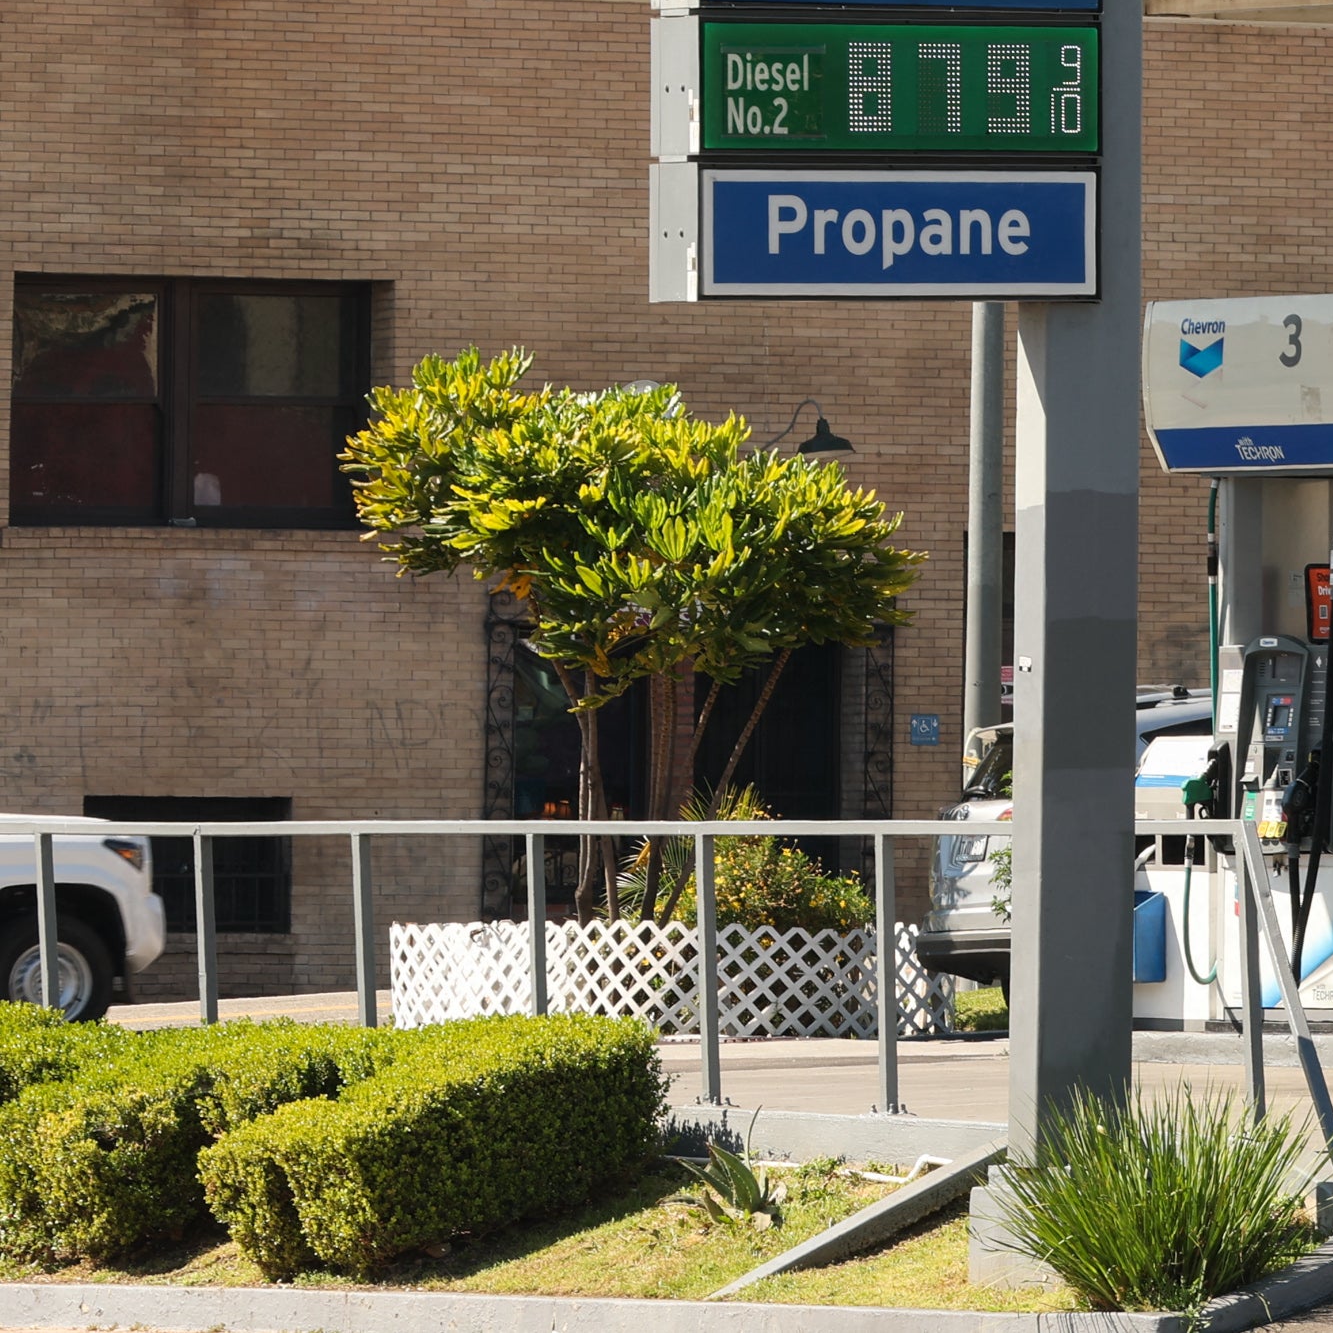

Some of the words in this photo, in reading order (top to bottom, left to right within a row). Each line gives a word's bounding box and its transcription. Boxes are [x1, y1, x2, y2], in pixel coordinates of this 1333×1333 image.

[726, 53, 810, 92] Diesel
[726, 97, 789, 135] No.2
[767, 194, 1031, 270] Propane
[1181, 318, 1226, 335] Chevron
[1279, 313, 1303, 368] 3
[1234, 443, 1285, 463] TECHRON
[1238, 436, 1254, 447] with
